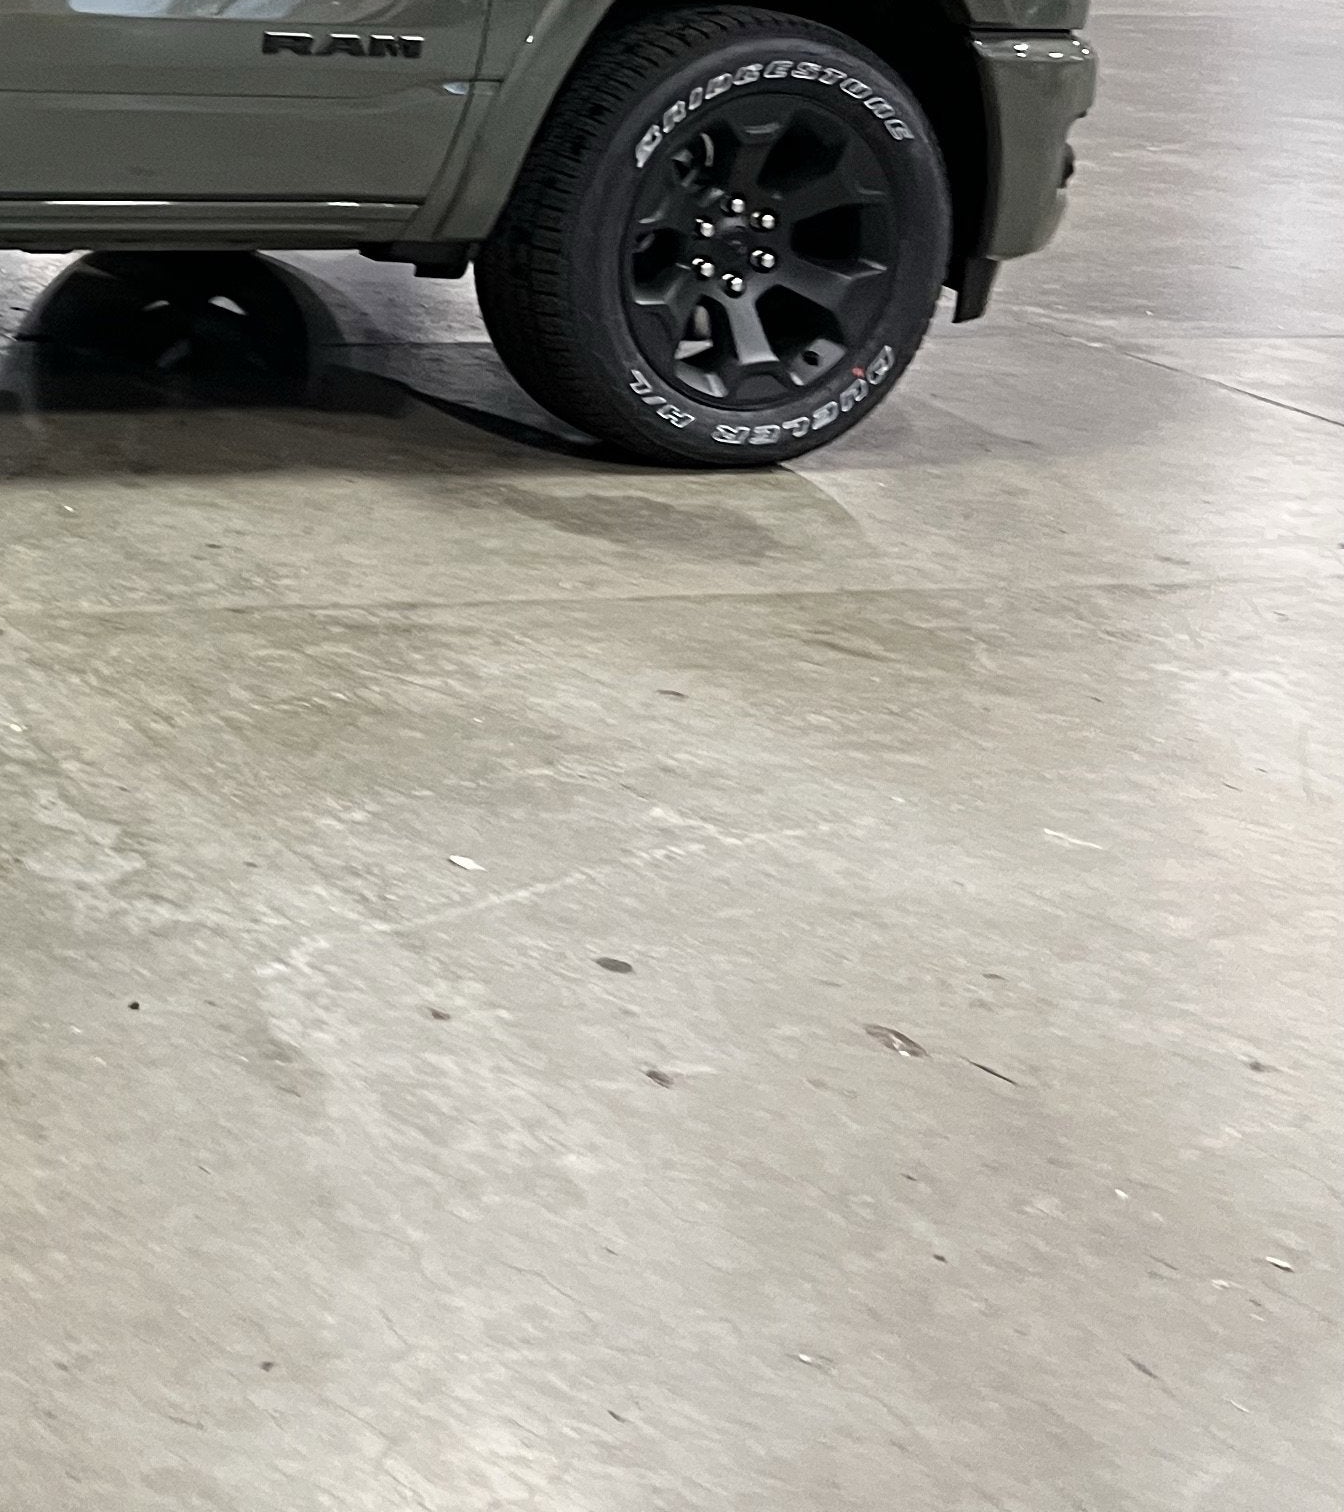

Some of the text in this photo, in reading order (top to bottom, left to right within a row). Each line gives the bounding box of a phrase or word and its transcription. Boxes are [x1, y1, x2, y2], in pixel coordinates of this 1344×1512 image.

[262, 31, 424, 58] RAM
[635, 59, 914, 168] BRIDGESTONE
[712, 345, 893, 446] DUELER
